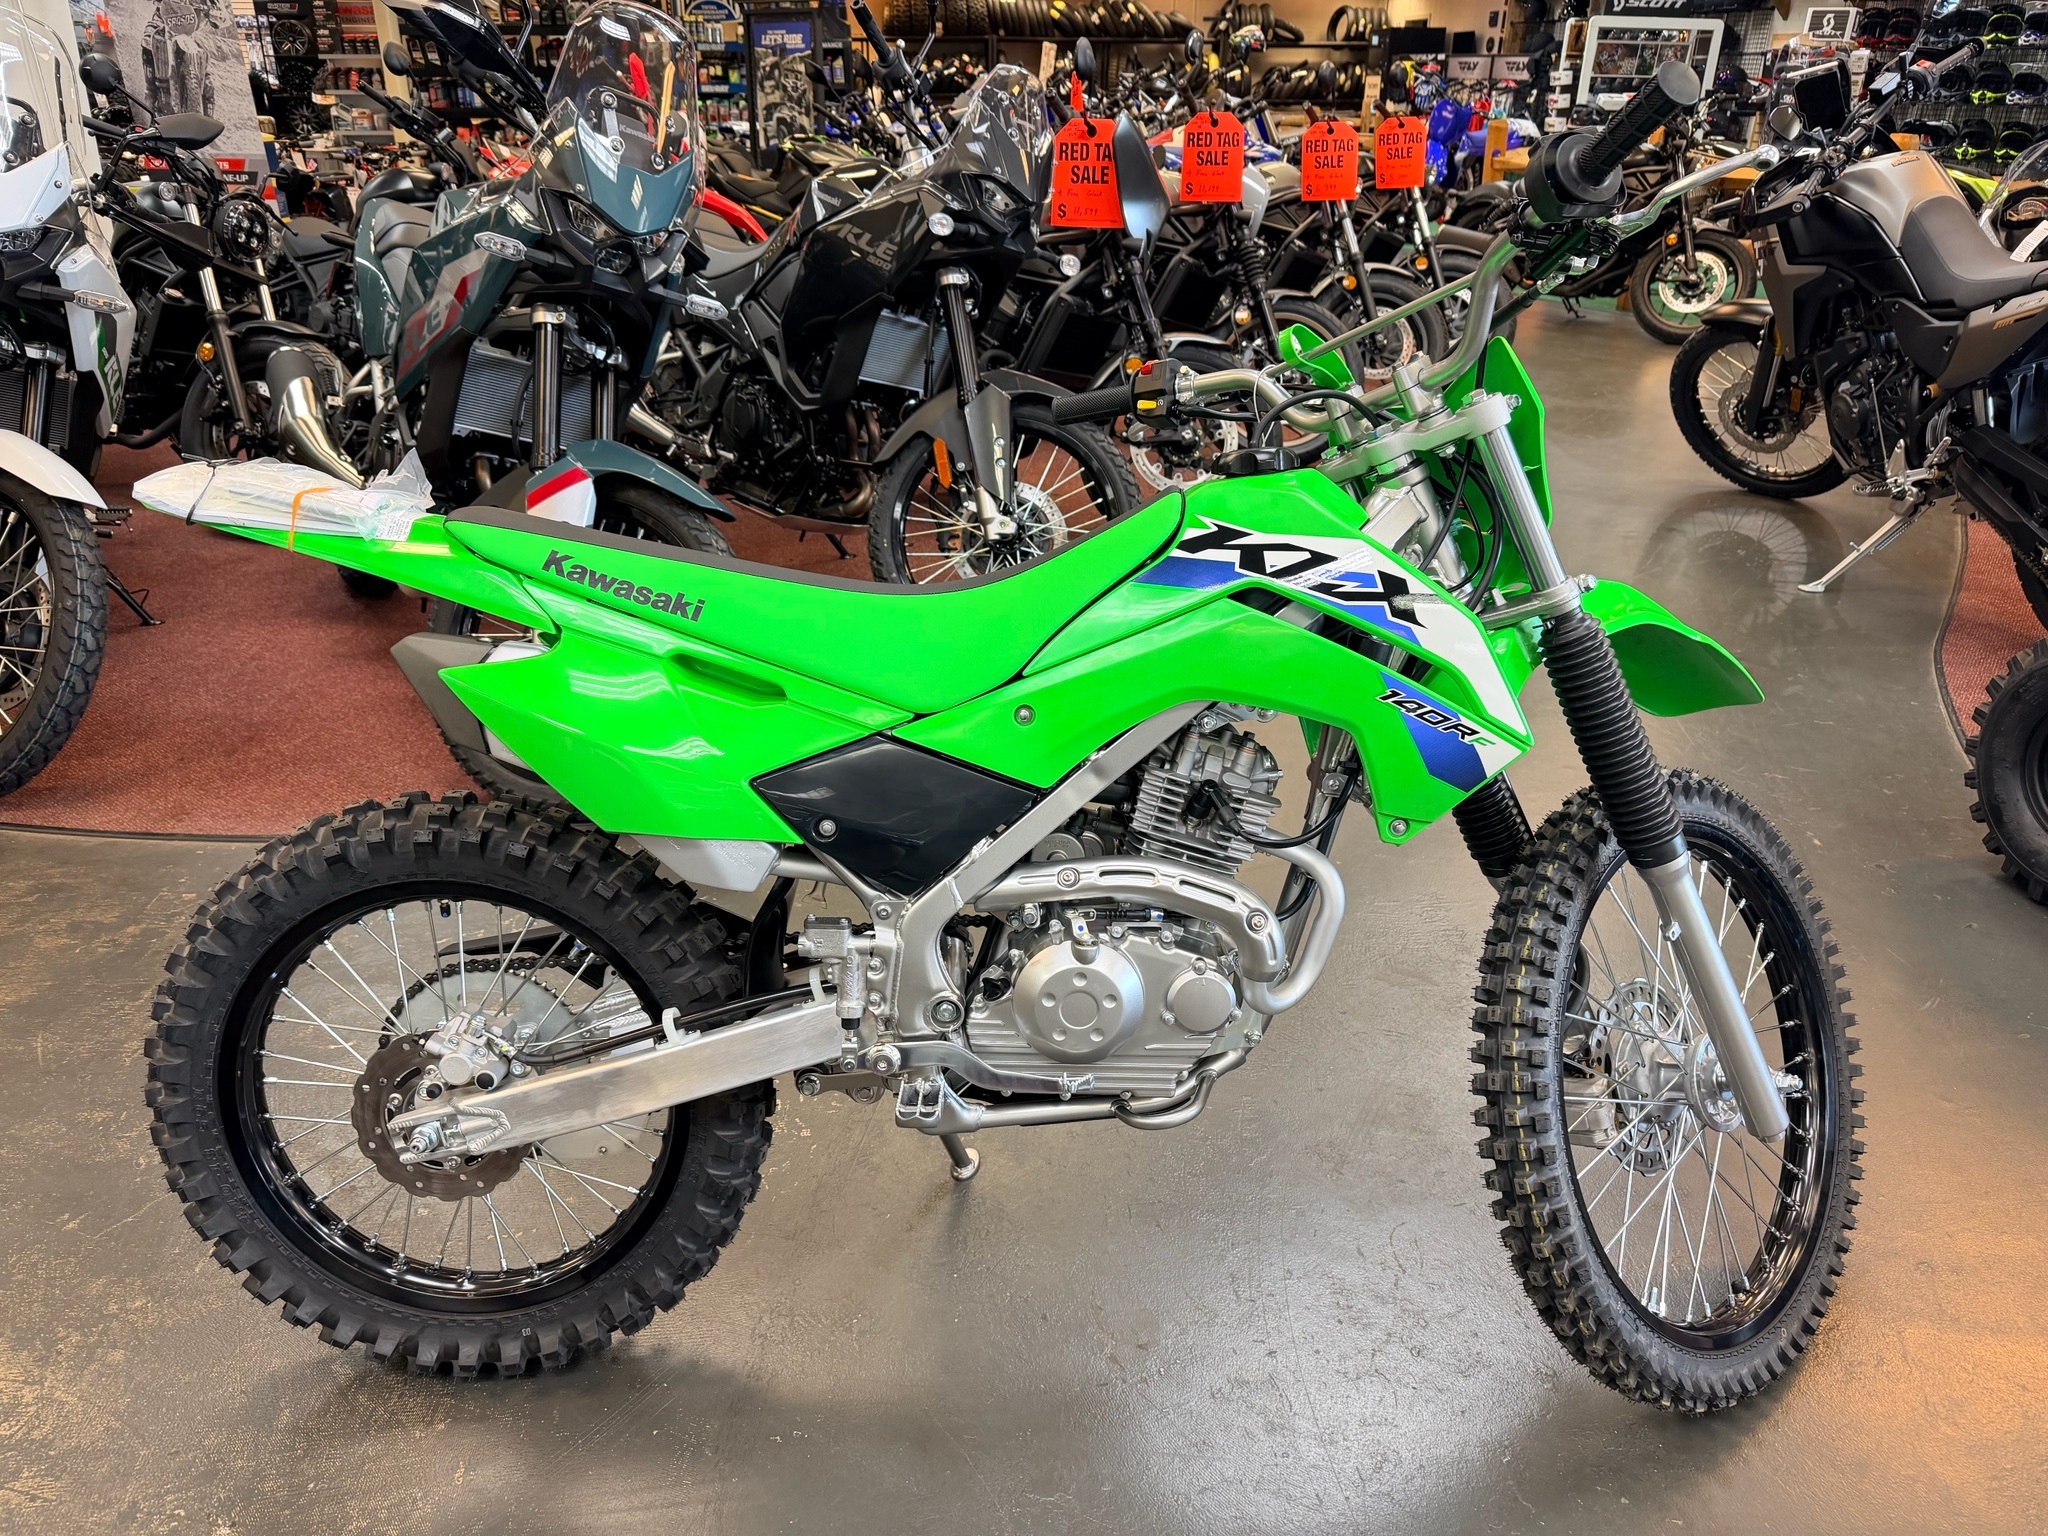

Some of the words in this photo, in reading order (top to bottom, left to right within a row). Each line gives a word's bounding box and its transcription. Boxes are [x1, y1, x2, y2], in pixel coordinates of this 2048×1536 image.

[619, 123, 656, 142] Kawasak
[1187, 132, 1213, 147] RED
[1217, 132, 1240, 147] TAG
[1376, 133, 1399, 146] RED
[1403, 132, 1422, 144] TAG
[1059, 142, 1090, 161] RED
[1094, 142, 1112, 162] TA
[1305, 139, 1329, 153] RED
[1332, 139, 1354, 152] TAG
[1387, 147, 1413, 160] SALE
[1196, 151, 1229, 166] SALE
[1314, 155, 1344, 169] SALE
[1070, 165, 1110, 184] SALE
[1379, 173, 1386, 184] $
[1185, 182, 1194, 196] $
[1305, 183, 1313, 196] $
[1057, 203, 1067, 219] $
[837, 222, 899, 262] KLE
[866, 254, 893, 271] 500
[541, 549, 706, 623] Kawasaki
